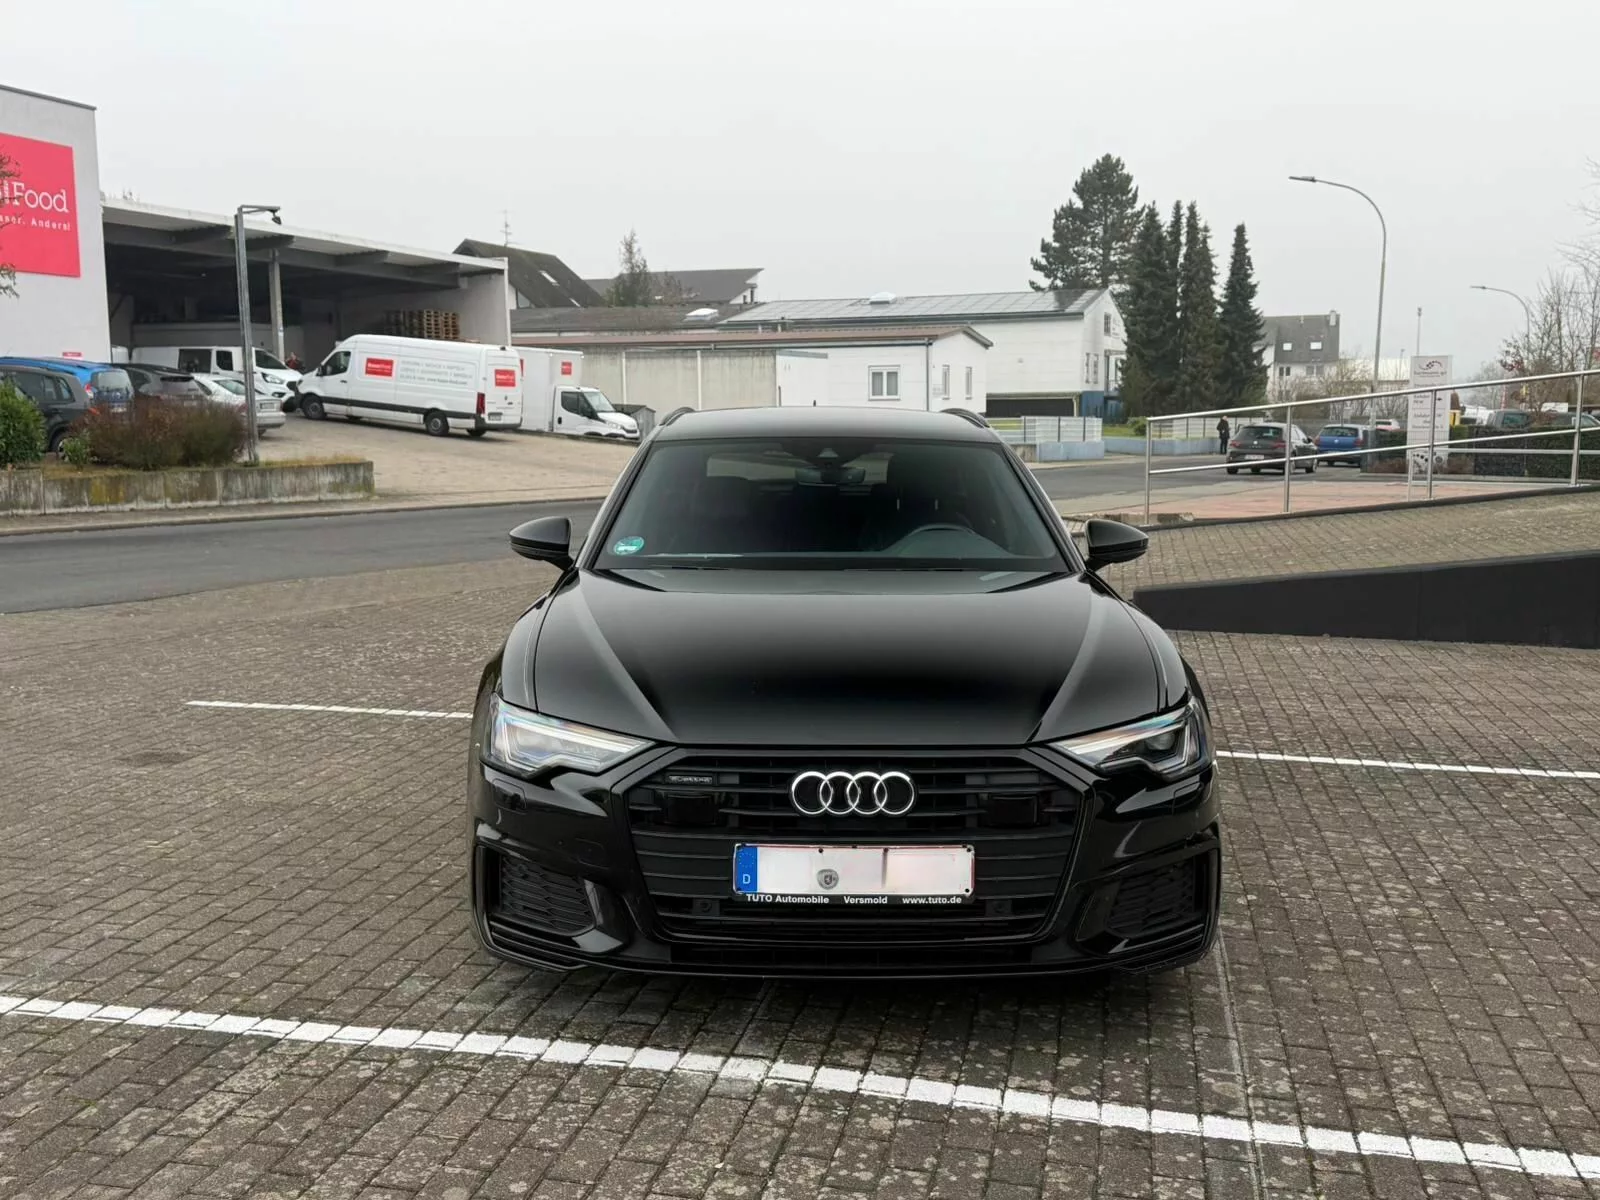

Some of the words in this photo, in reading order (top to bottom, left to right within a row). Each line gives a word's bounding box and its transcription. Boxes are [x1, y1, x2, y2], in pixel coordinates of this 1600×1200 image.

[742, 873, 751, 885] D
[746, 894, 773, 902] TUTO
[775, 895, 830, 904] Automobile
[843, 895, 888, 905] Versmold
[902, 895, 962, 905] www.tuto.de
